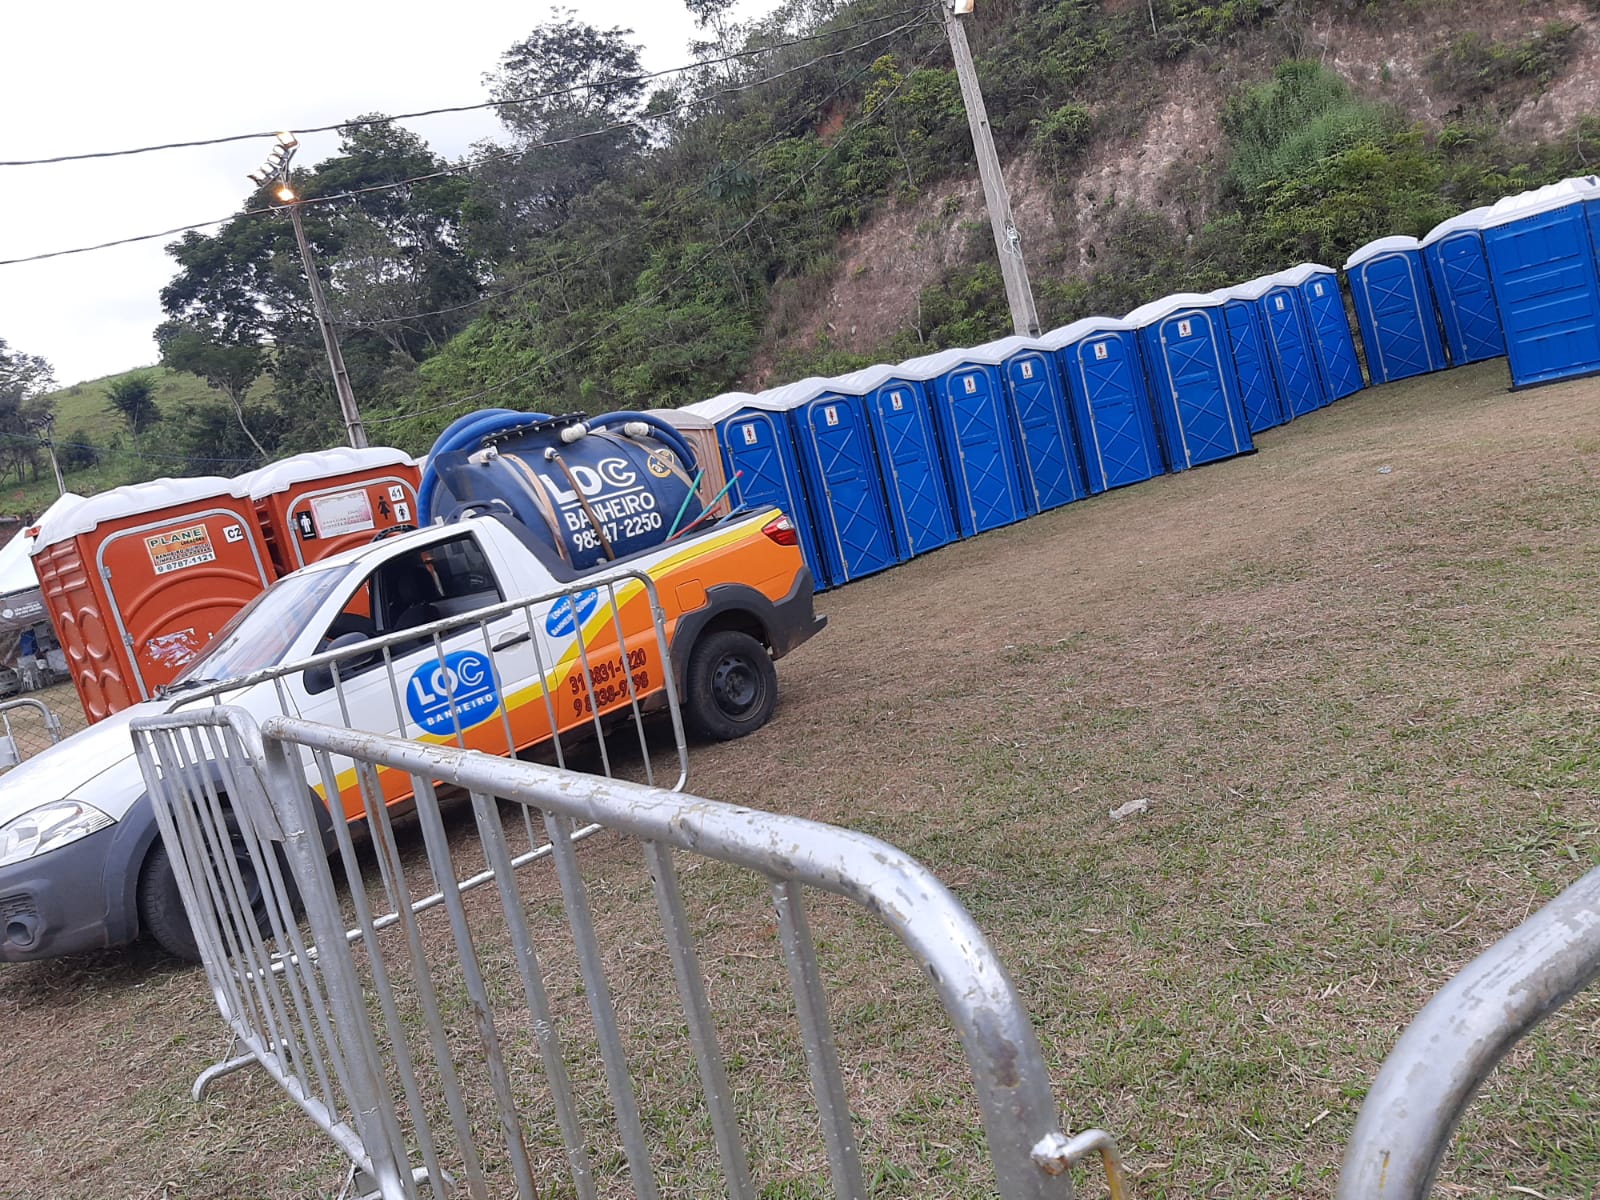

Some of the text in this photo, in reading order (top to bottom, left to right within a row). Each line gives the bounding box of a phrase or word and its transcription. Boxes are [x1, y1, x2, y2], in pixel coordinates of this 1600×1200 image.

[539, 457, 636, 504] LOC
[391, 487, 403, 499] 41
[564, 492, 656, 531] BANHEIRO
[150, 528, 202, 548] PLANE
[227, 527, 243, 539] C2
[572, 512, 662, 552] 98547-2250
[157, 553, 214, 573] 9 8787-1121
[412, 656, 485, 706] LOC
[569, 673, 587, 695] 31
[426, 694, 493, 726] BANHEIRO
[573, 698, 583, 717] 9
